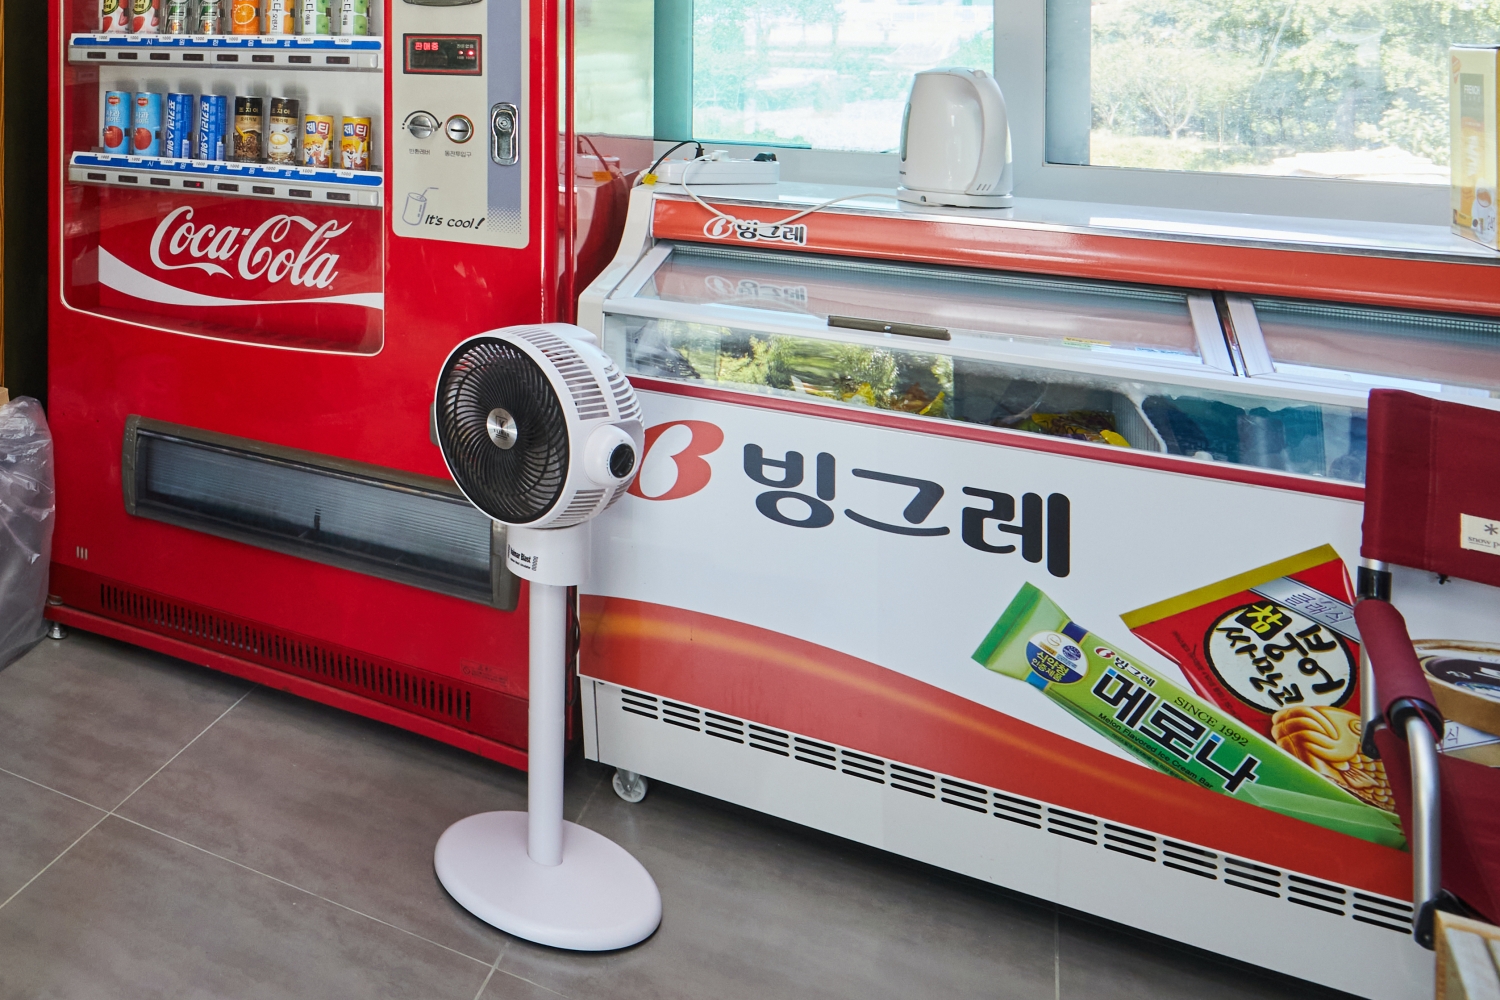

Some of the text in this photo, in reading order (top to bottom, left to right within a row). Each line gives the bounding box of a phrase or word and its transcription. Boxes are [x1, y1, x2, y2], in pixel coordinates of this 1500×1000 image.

[415, 42, 439, 50] 판매중
[1464, 84, 1481, 95] FRENCH
[306, 122, 329, 134] 제티
[344, 123, 367, 136] 제티
[424, 214, 443, 226] It's
[736, 220, 804, 244] 빙그레
[150, 205, 352, 289] Coca-Cola
[743, 443, 1071, 578] 빙그레
[1468, 535, 1491, 546] snow
[1246, 605, 1283, 633] 참
[1285, 592, 1353, 623] 클래식
[1031, 659, 1063, 682] 인증제품
[1036, 650, 1069, 675] 식약청
[1114, 656, 1156, 687] 빙그레
[1216, 627, 1304, 707] 싸만코
[1092, 667, 1260, 794] 메로나
[1174, 697, 1249, 747] SINCE 1992
[1098, 713, 1214, 790] Melon Flavored Ice Cream Bar
